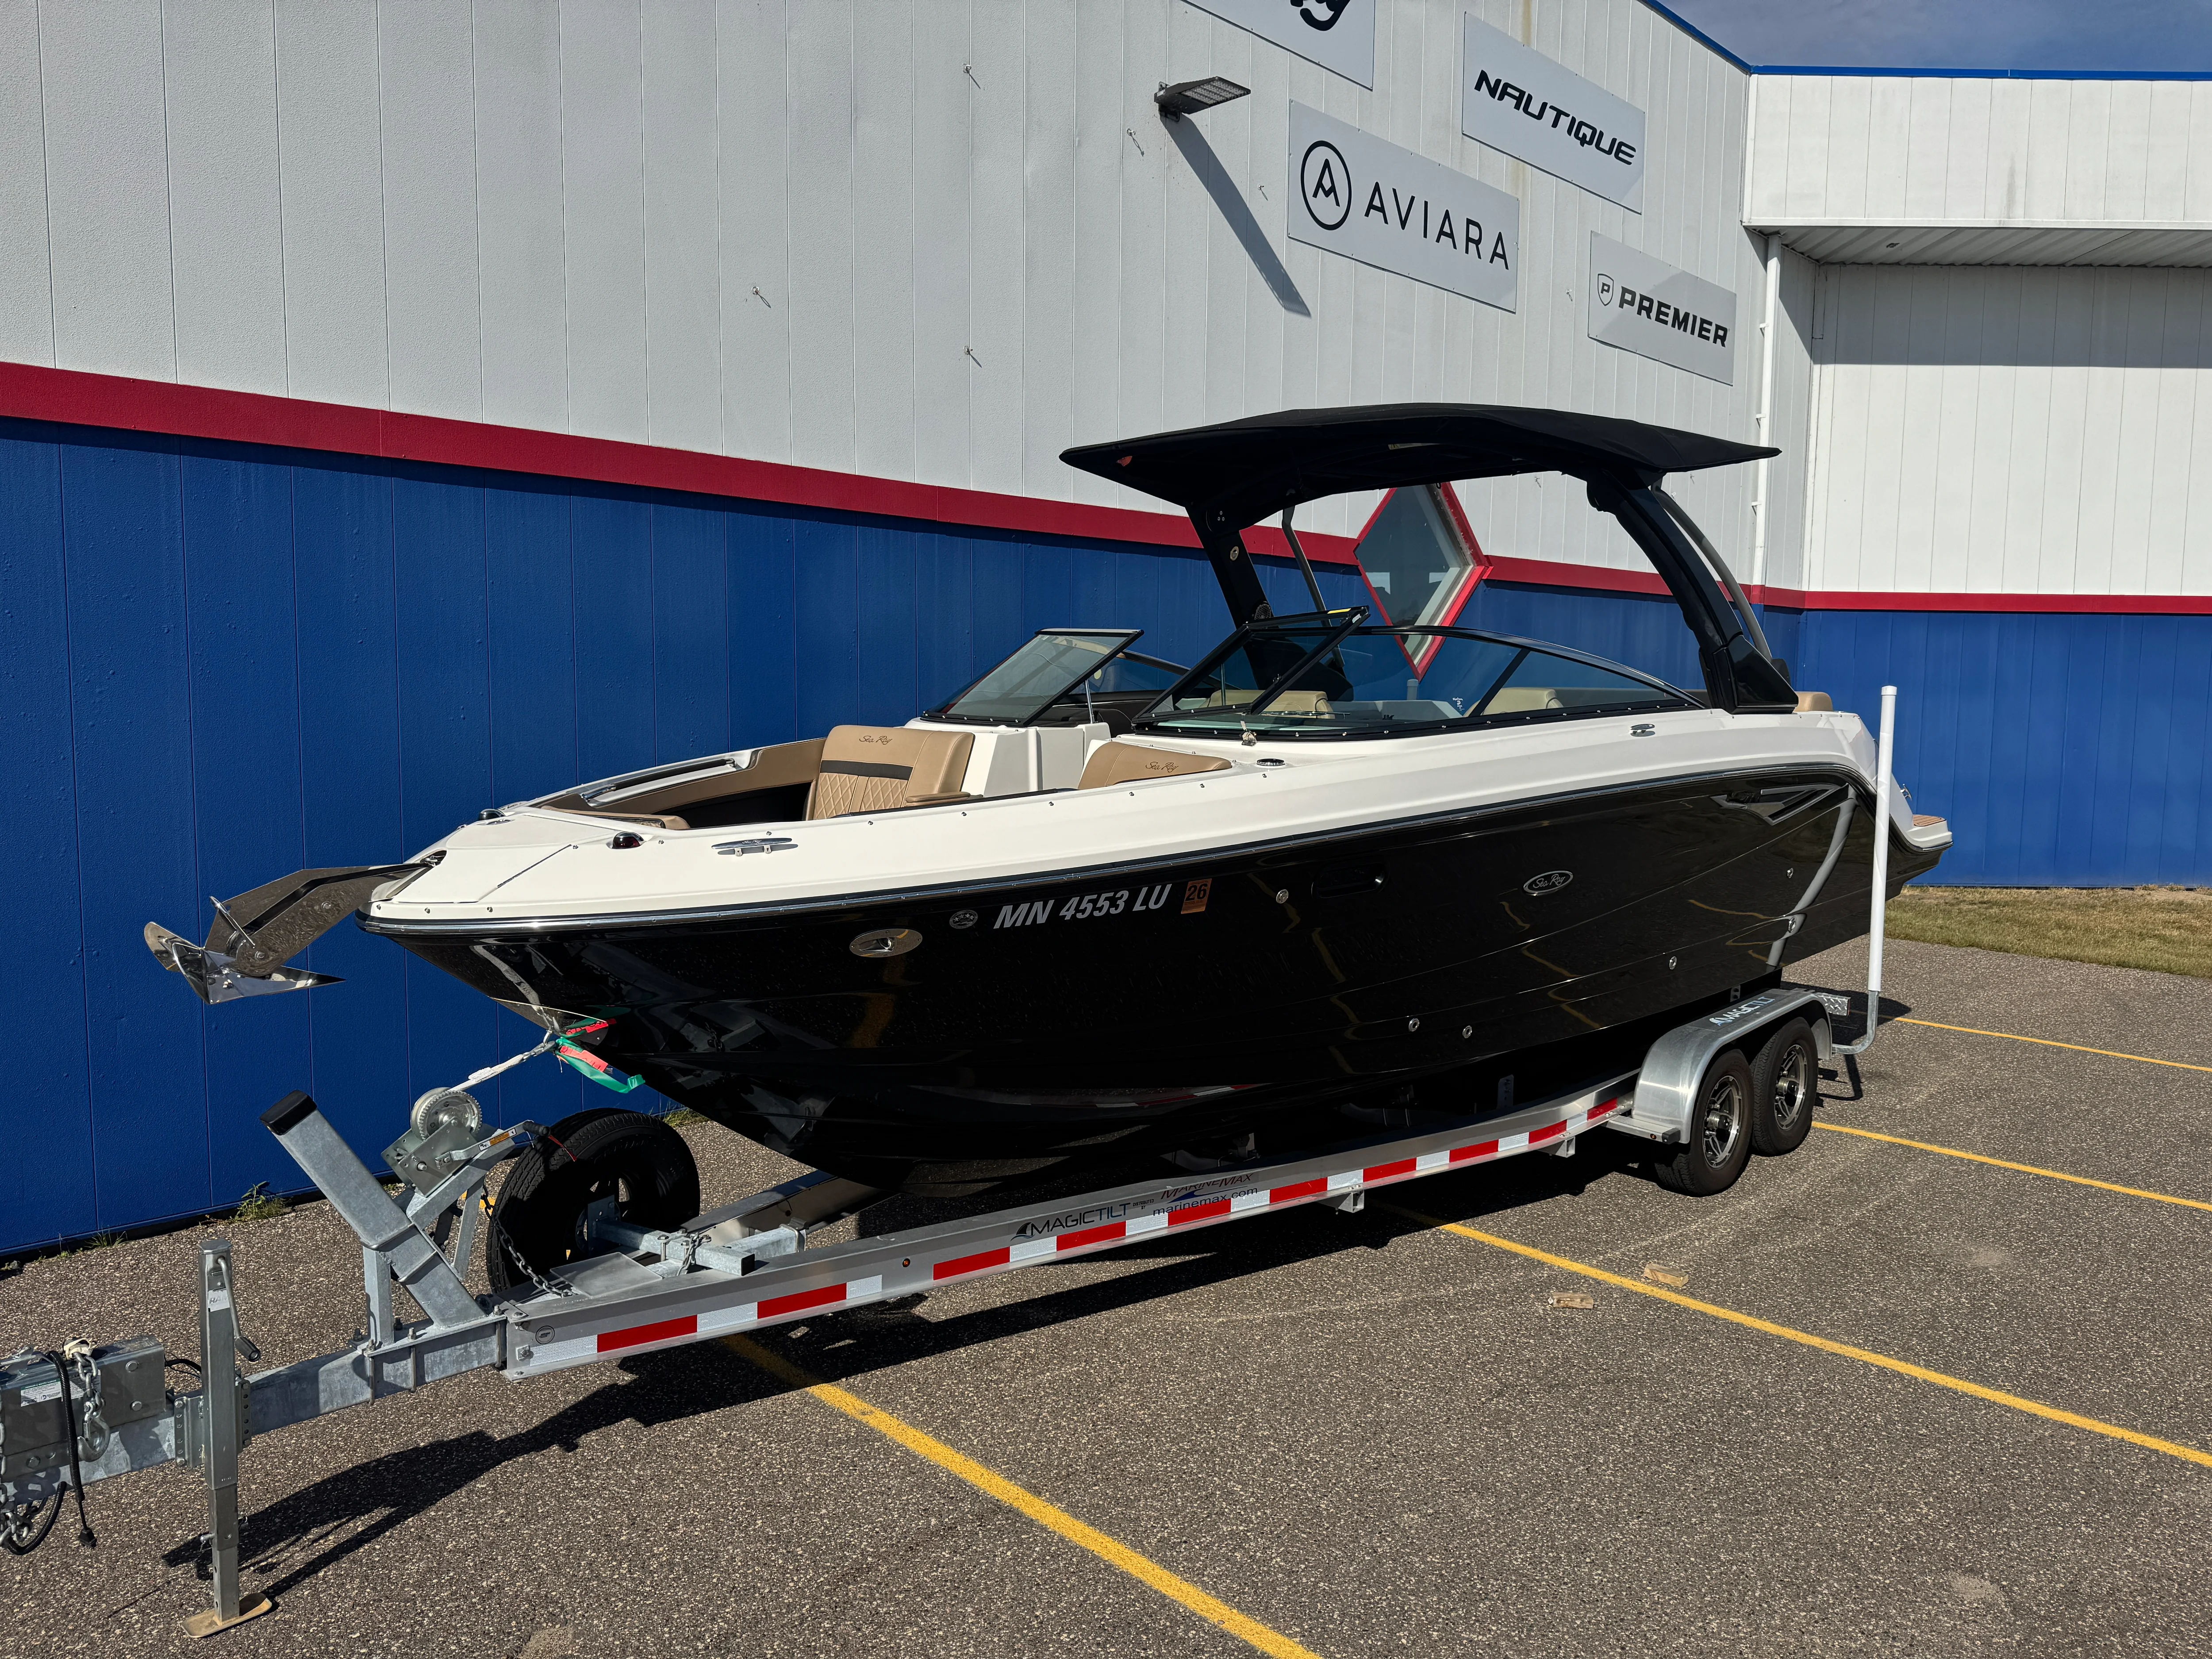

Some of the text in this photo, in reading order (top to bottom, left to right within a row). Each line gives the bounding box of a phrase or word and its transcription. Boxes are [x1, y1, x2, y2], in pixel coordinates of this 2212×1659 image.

[1474, 69, 1636, 165] NAUTIQUE
[1364, 181, 1509, 270] AVIARA
[1618, 285, 1728, 348] PREMIER
[876, 735, 893, 745] Ray
[1145, 761, 1179, 773] Sea Ray
[1185, 883, 1208, 902] 26
[1533, 874, 1566, 888] Sea Ray
[993, 899, 1055, 929] MN
[1059, 890, 1129, 920] 4553
[1132, 883, 1172, 911] LU
[1153, 1187, 1258, 1217] marinemax.com
[1030, 1202, 1131, 1236] MAGICTILT
